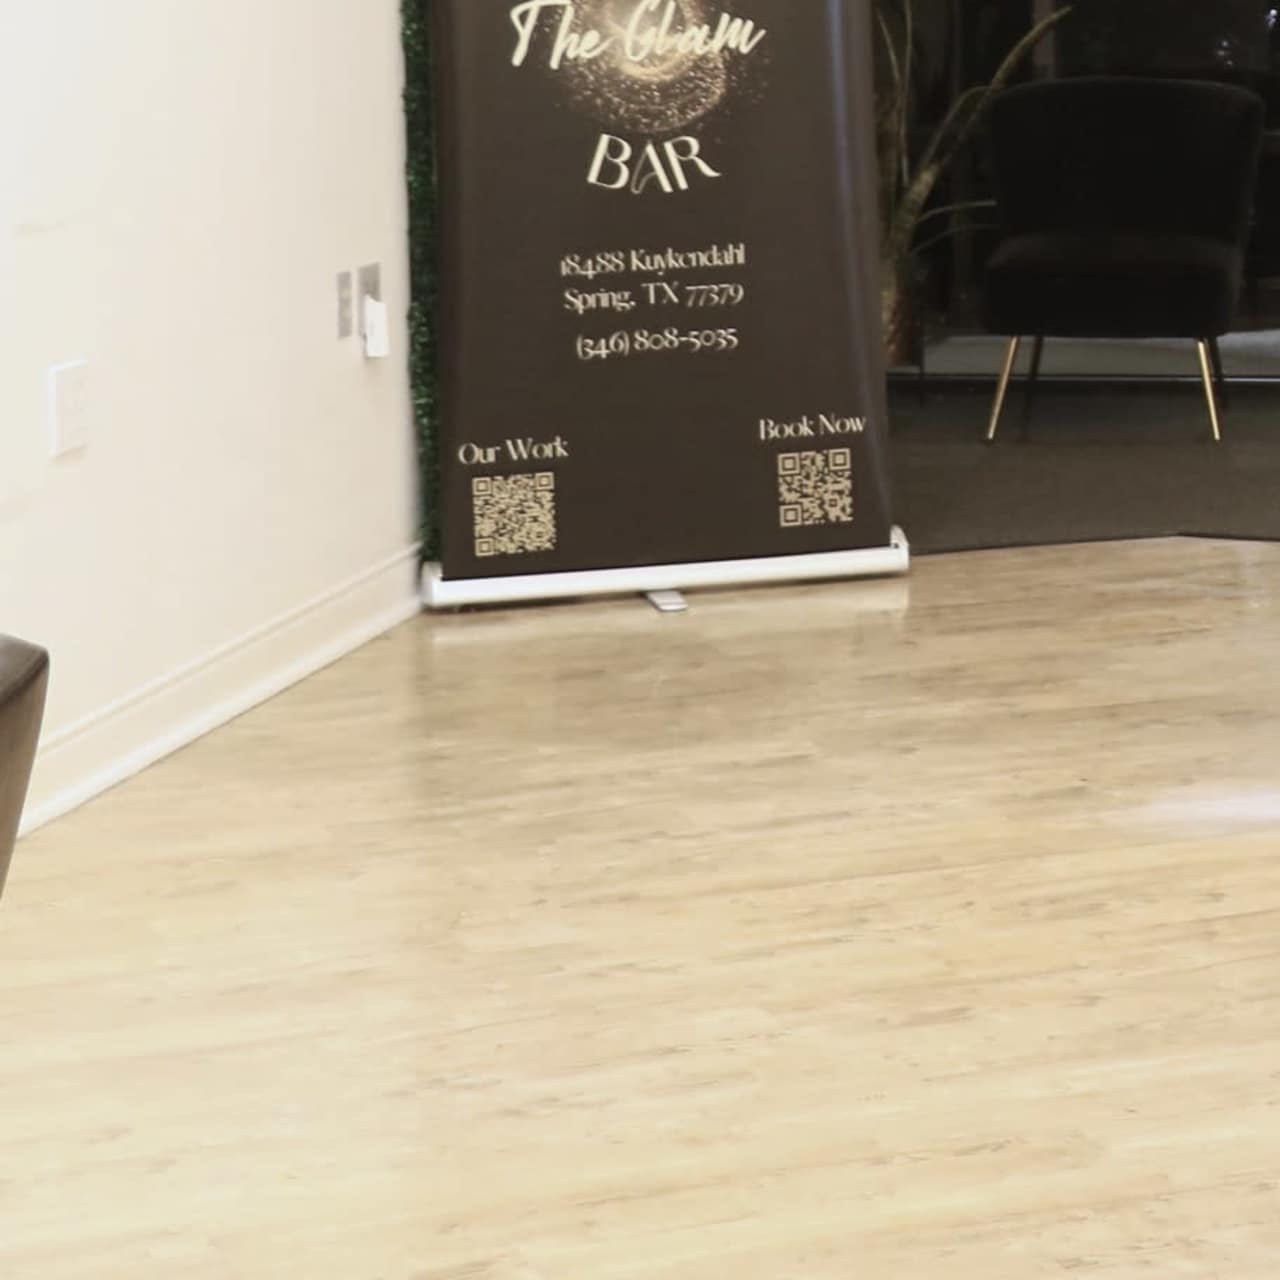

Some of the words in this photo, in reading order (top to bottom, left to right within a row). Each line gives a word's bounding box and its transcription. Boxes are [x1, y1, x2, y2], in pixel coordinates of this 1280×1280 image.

[587, 133, 722, 194] BAR
[560, 250, 625, 279] 18488
[630, 243, 745, 276] Kuykendahl
[641, 281, 680, 305] TX
[685, 283, 744, 308] 77379
[576, 330, 631, 360] (346)
[634, 327, 739, 353] 808-5035
[759, 415, 815, 441] Book
[819, 413, 867, 436] Now
[458, 442, 501, 465] Our
[506, 436, 569, 463] Work
